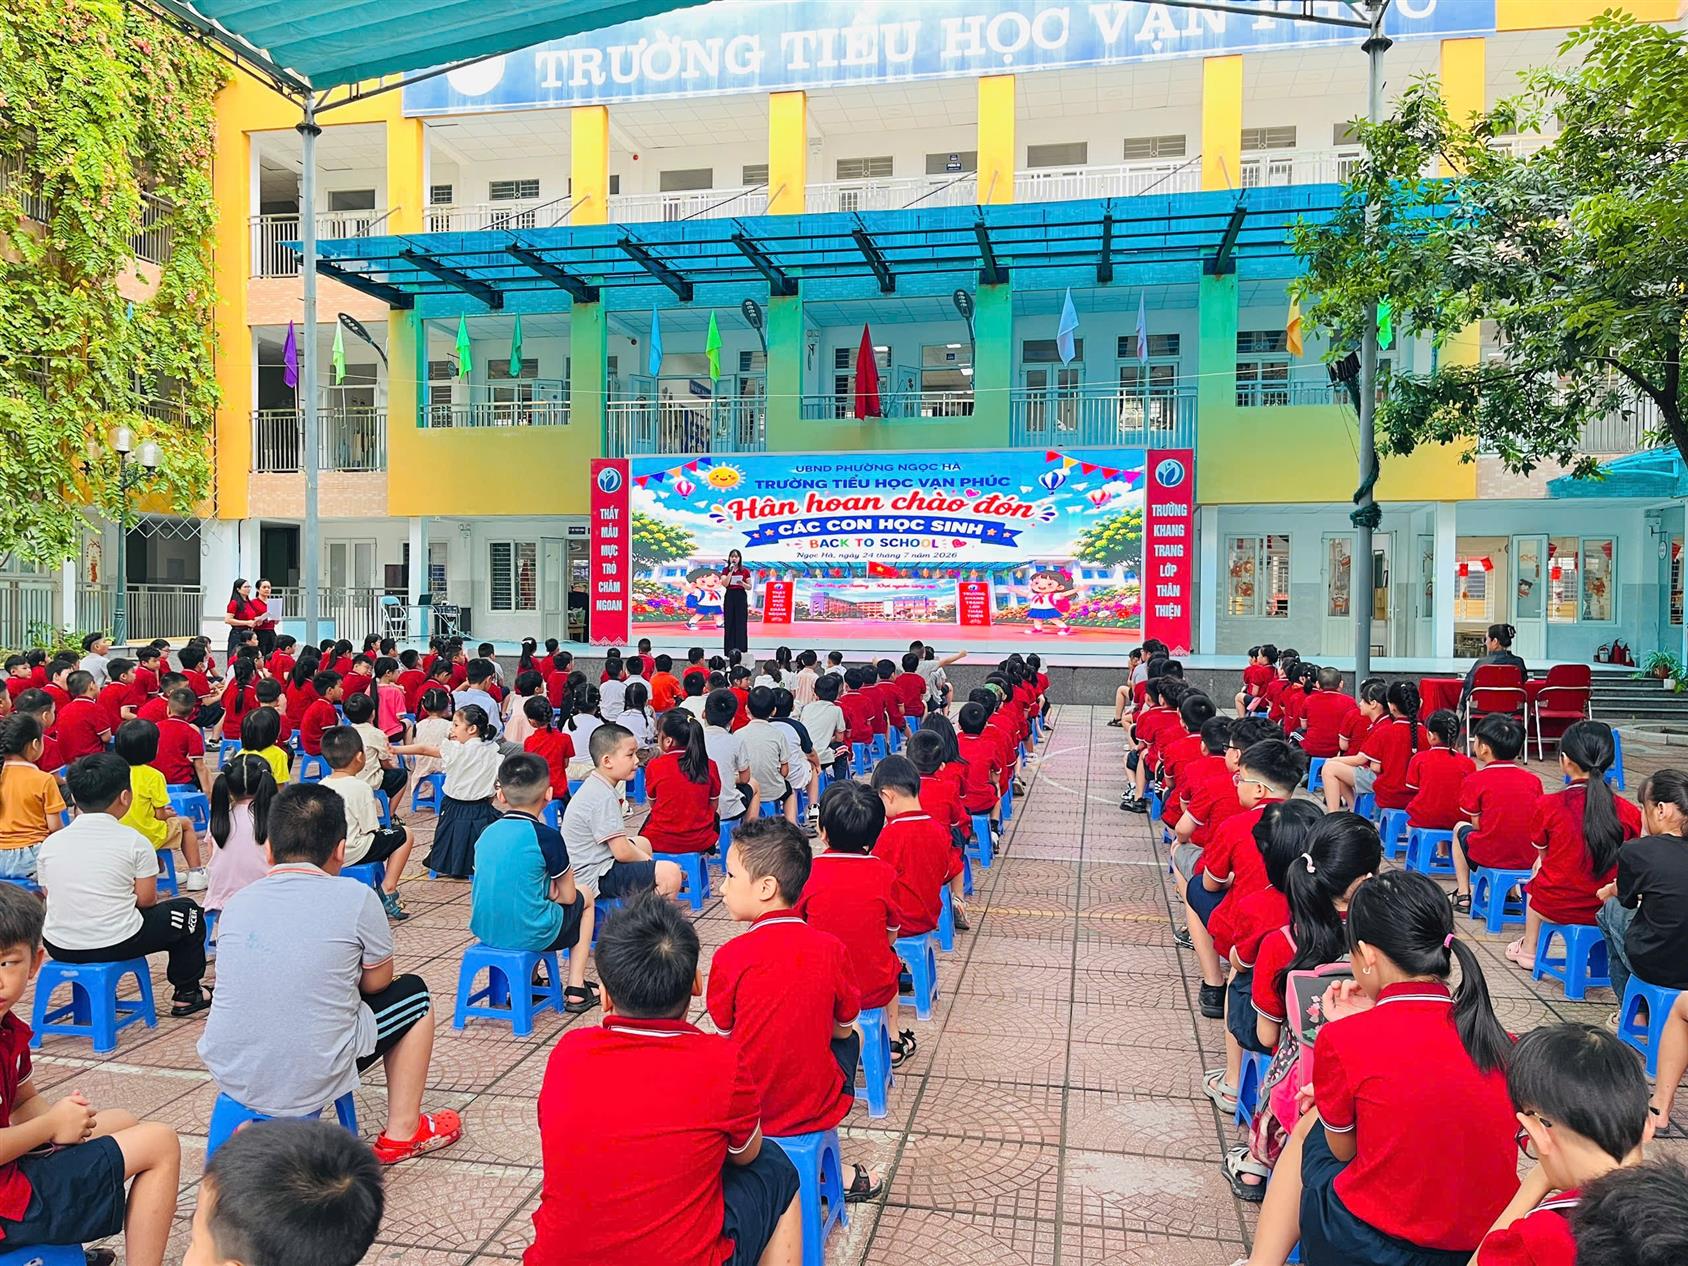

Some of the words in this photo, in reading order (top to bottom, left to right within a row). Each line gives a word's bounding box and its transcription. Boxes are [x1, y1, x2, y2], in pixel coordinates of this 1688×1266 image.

[535, 29, 765, 88] TRƯỜNG
[940, 6, 1070, 63] HỌC
[1087, 1, 1227, 50] VẠN
[836, 463, 894, 472] PHƯỜNG
[898, 463, 938, 473] NGỌC
[942, 461, 961, 471] HÀ
[755, 476, 828, 490] TRƯỜNG
[832, 475, 870, 489] TIỂU
[875, 478, 913, 490] HỌC
[918, 478, 955, 490] VẠN
[960, 475, 1010, 488] PHÚC
[728, 498, 799, 521] Hân
[806, 493, 884, 513] hoan
[891, 490, 969, 512] chào
[973, 494, 1034, 518] đón
[1152, 502, 1187, 516] TRƯỜNG
[778, 520, 820, 535] CÁC
[827, 518, 872, 531] CON
[879, 518, 925, 533] HỌC
[931, 520, 984, 535] SINH
[1154, 524, 1184, 536] KHANG
[810, 538, 849, 549] BACK
[855, 538, 875, 548] TO
[880, 538, 939, 548] SCHOOL
[1154, 544, 1183, 557] TRANG
[1160, 562, 1177, 577] LỚP
[1156, 582, 1180, 597] THÂN
[597, 599, 622, 611] NGOAN
[1155, 602, 1181, 619] THIỆN
